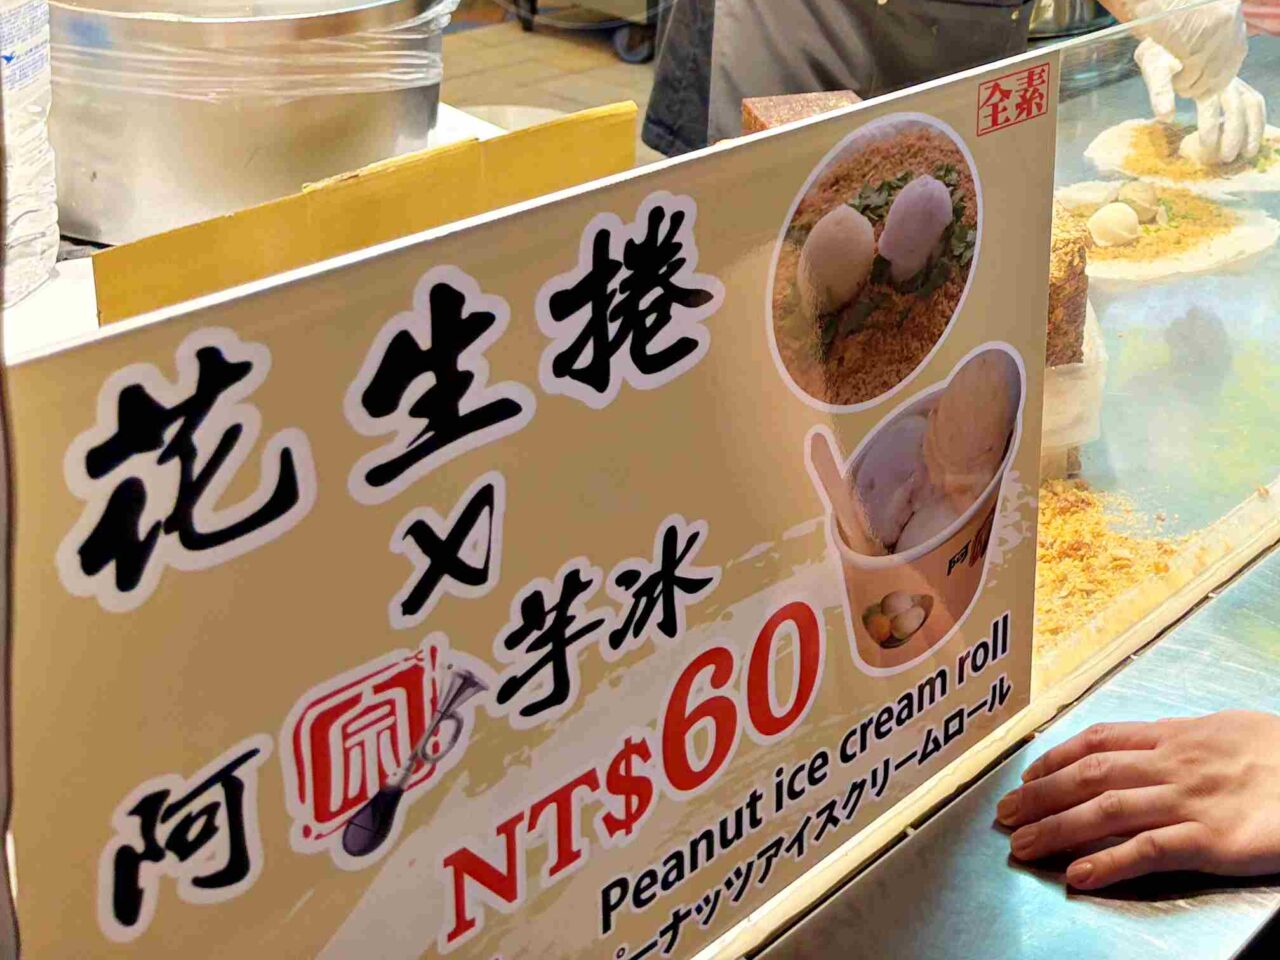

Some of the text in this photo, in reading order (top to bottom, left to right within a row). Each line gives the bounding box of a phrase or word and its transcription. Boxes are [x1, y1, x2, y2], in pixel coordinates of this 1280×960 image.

[77, 206, 714, 591] 花生捲
[443, 601, 820, 944] NT$60
[601, 614, 1009, 934] Peanut ice cream roll
[616, 676, 1012, 960] ーナッツアイスクリームロール
